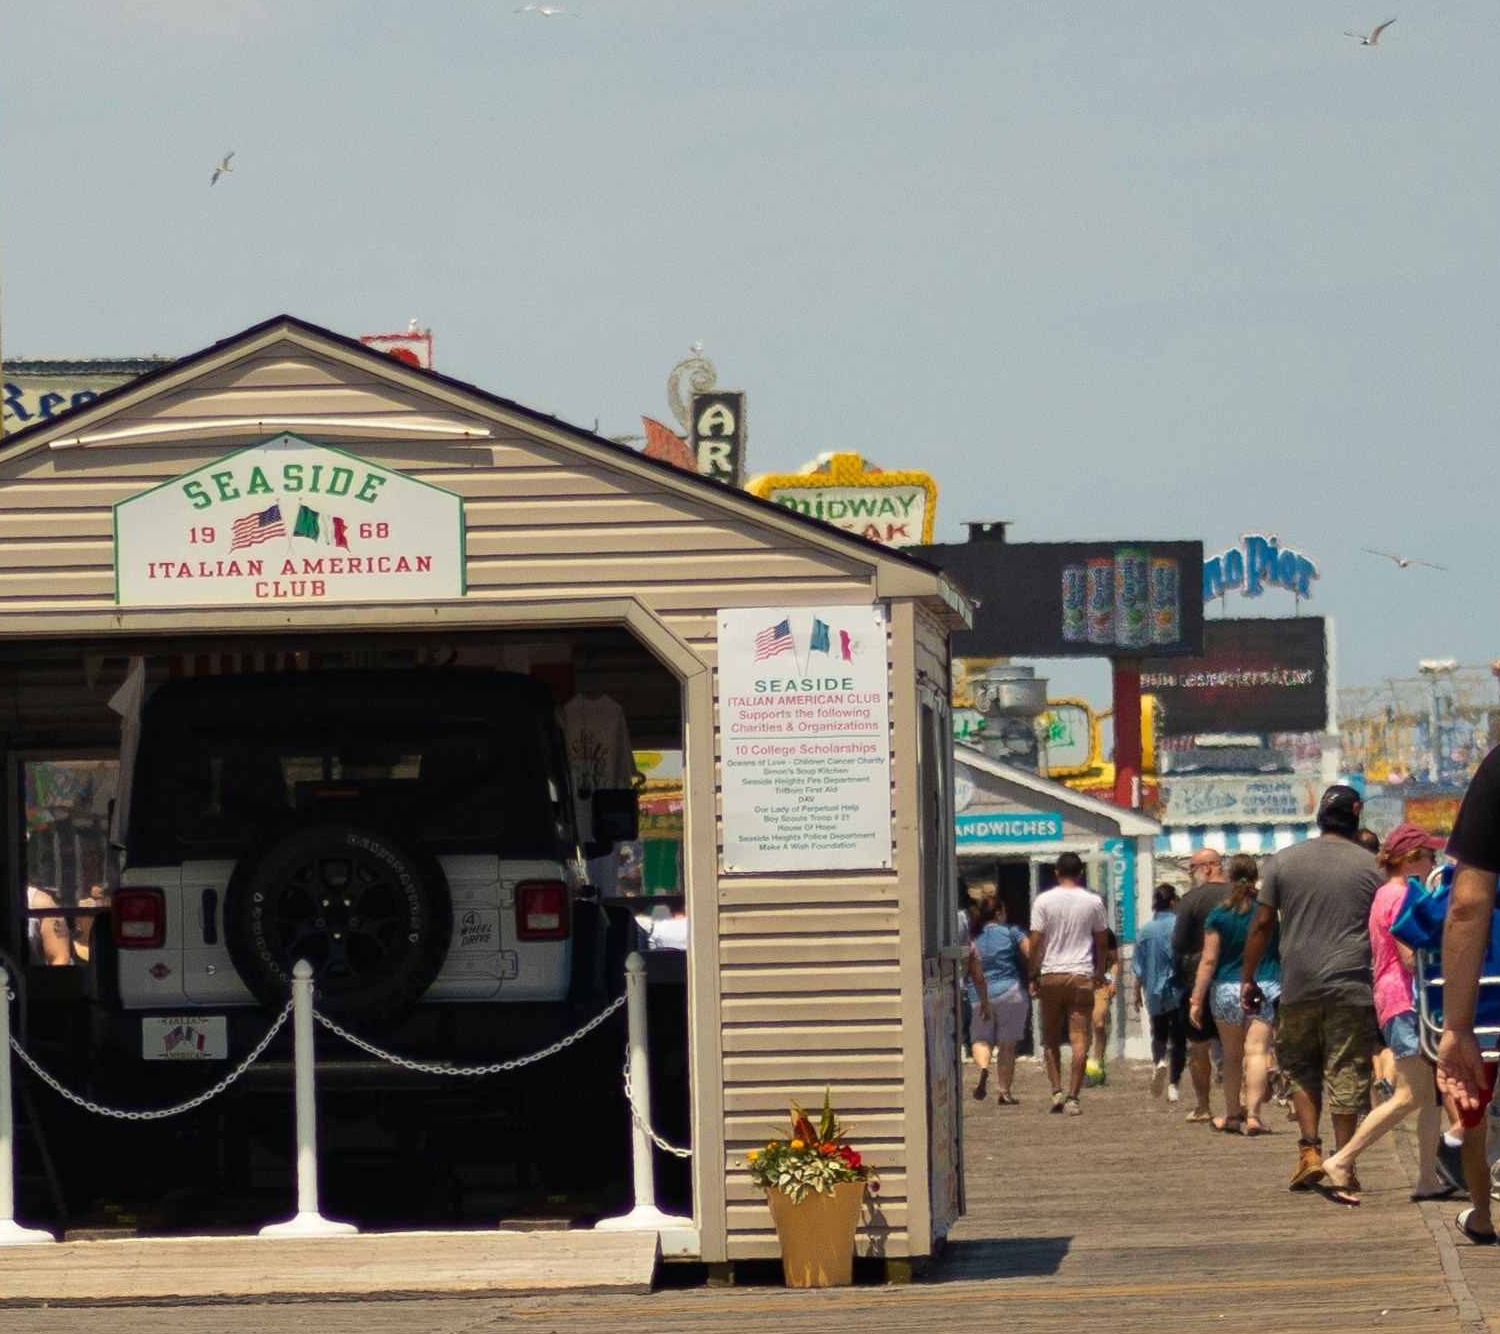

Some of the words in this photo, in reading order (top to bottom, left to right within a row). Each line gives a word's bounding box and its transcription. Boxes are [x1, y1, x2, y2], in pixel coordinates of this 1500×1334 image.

[181, 463, 387, 511] SEASIDE
[189, 527, 216, 545] 19
[359, 522, 390, 539] 68
[147, 559, 264, 579] ITALIAN
[279, 555, 433, 576] AMERICAN
[255, 580, 327, 598] CLUB
[754, 677, 854, 693] SEASIDE
[728, 696, 774, 707] ITALIAN
[777, 694, 843, 706] AMERICAN
[847, 693, 880, 704] CLUB
[739, 709, 791, 721] Supports
[795, 708, 814, 718] the
[817, 707, 870, 720] following
[731, 722, 783, 733] Charities
[786, 722, 794, 732] &
[798, 721, 879, 734] Organizations
[735, 746, 748, 755] 10
[751, 745, 796, 757] College
[800, 743, 877, 756] Scholarships
[727, 759, 756, 767] Oceans
[827, 757, 855, 765] Cancer
[857, 757, 885, 765] Charity
[762, 768, 795, 776] Simon's
[796, 768, 816, 776] Soup
[817, 767, 849, 775] Kitchen
[741, 778, 773, 786] Seaside
[774, 778, 805, 786] Heights
[824, 776, 870, 786] Department
[771, 805, 790, 814] Lady
[791, 805, 800, 813] of
[801, 804, 839, 814] Perpetual
[841, 804, 859, 813] Help
[763, 815, 778, 824] Boy
[780, 815, 808, 823] Scouts
[810, 814, 832, 823] Troop
[777, 824, 802, 832] House
[956, 820, 1057, 838] ANDWICHES
[738, 834, 770, 842] Seaside
[772, 834, 801, 842] Heights
[803, 833, 828, 841] Police
[830, 832, 876, 842] Department
[811, 842, 856, 850] Foundation
